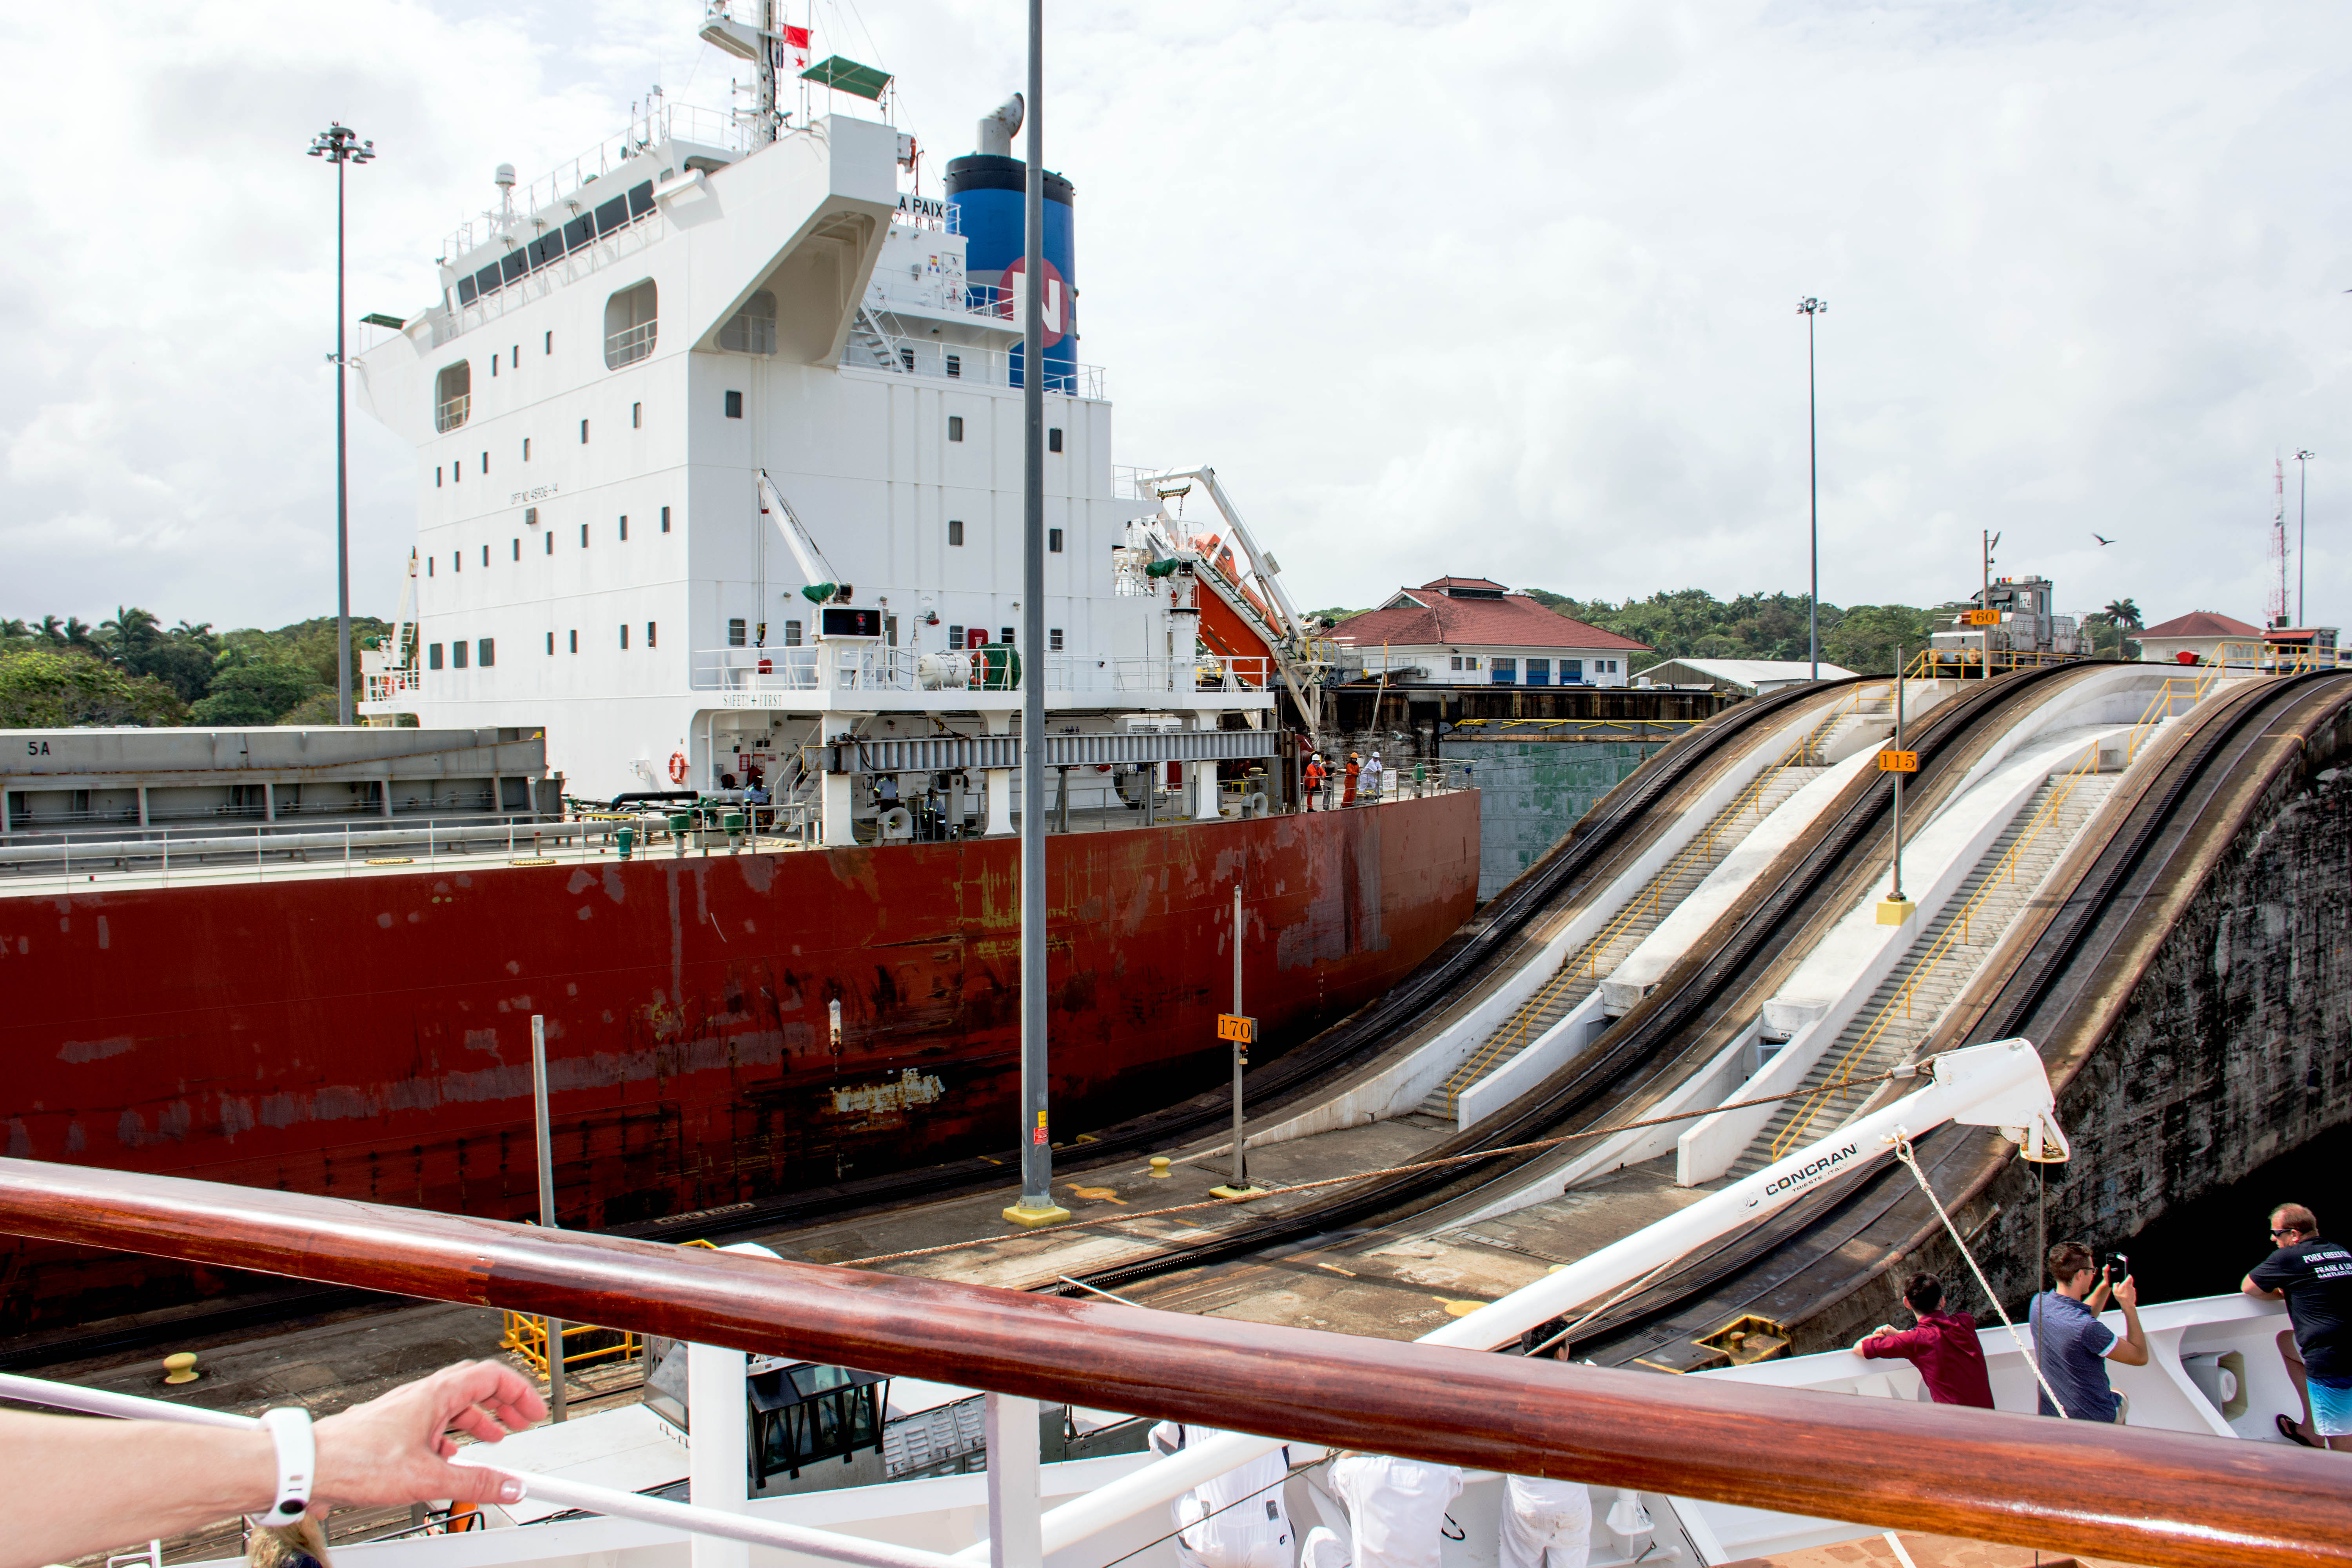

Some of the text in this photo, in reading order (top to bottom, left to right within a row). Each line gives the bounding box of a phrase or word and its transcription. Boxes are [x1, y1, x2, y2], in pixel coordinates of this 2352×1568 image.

[913, 198, 943, 219] PAIX
[2020, 599, 2031, 608] 174
[1976, 612, 1994, 622] 60
[724, 694, 782, 706] SAFETY FIRST
[28, 741, 50, 756] 5A
[1882, 754, 1915, 768] 115
[1220, 1019, 1250, 1038] 170
[1765, 1143, 1859, 1196] CONCRAN
[1791, 1175, 1823, 1192] TRIESTE
[1827, 1163, 1847, 1175] ITALY
[2302, 1253, 2325, 1263] PORK
[2314, 1265, 2339, 1274] FRANK
